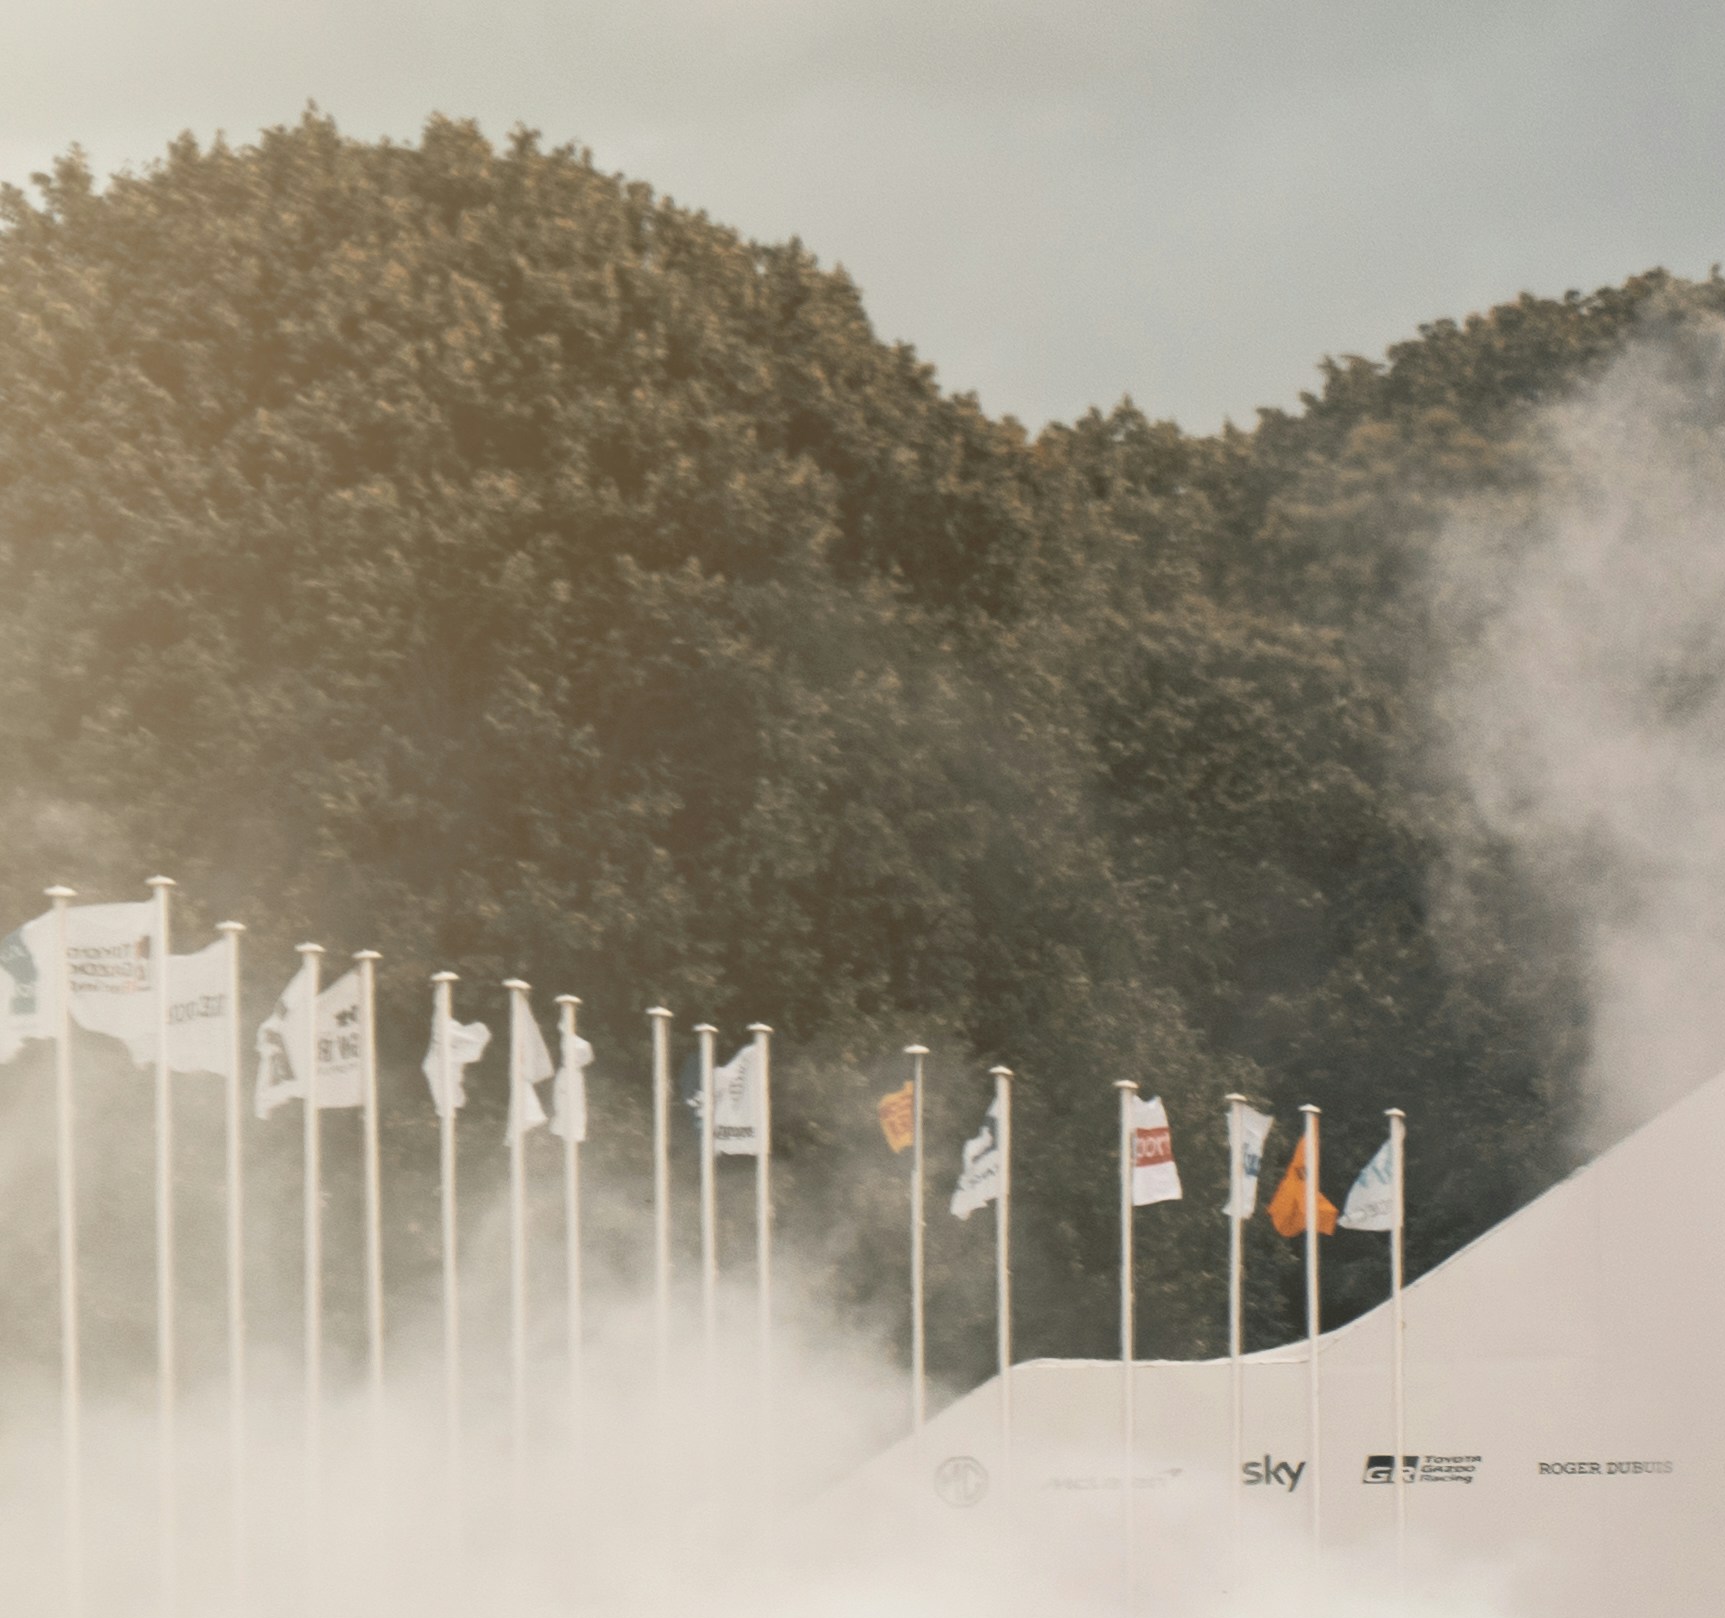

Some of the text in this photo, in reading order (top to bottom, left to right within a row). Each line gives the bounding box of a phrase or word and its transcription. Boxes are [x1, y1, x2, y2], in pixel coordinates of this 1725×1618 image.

[1242, 1454, 1306, 1491] sky
[1538, 1461, 1674, 1475] ROGER DUBUIS
